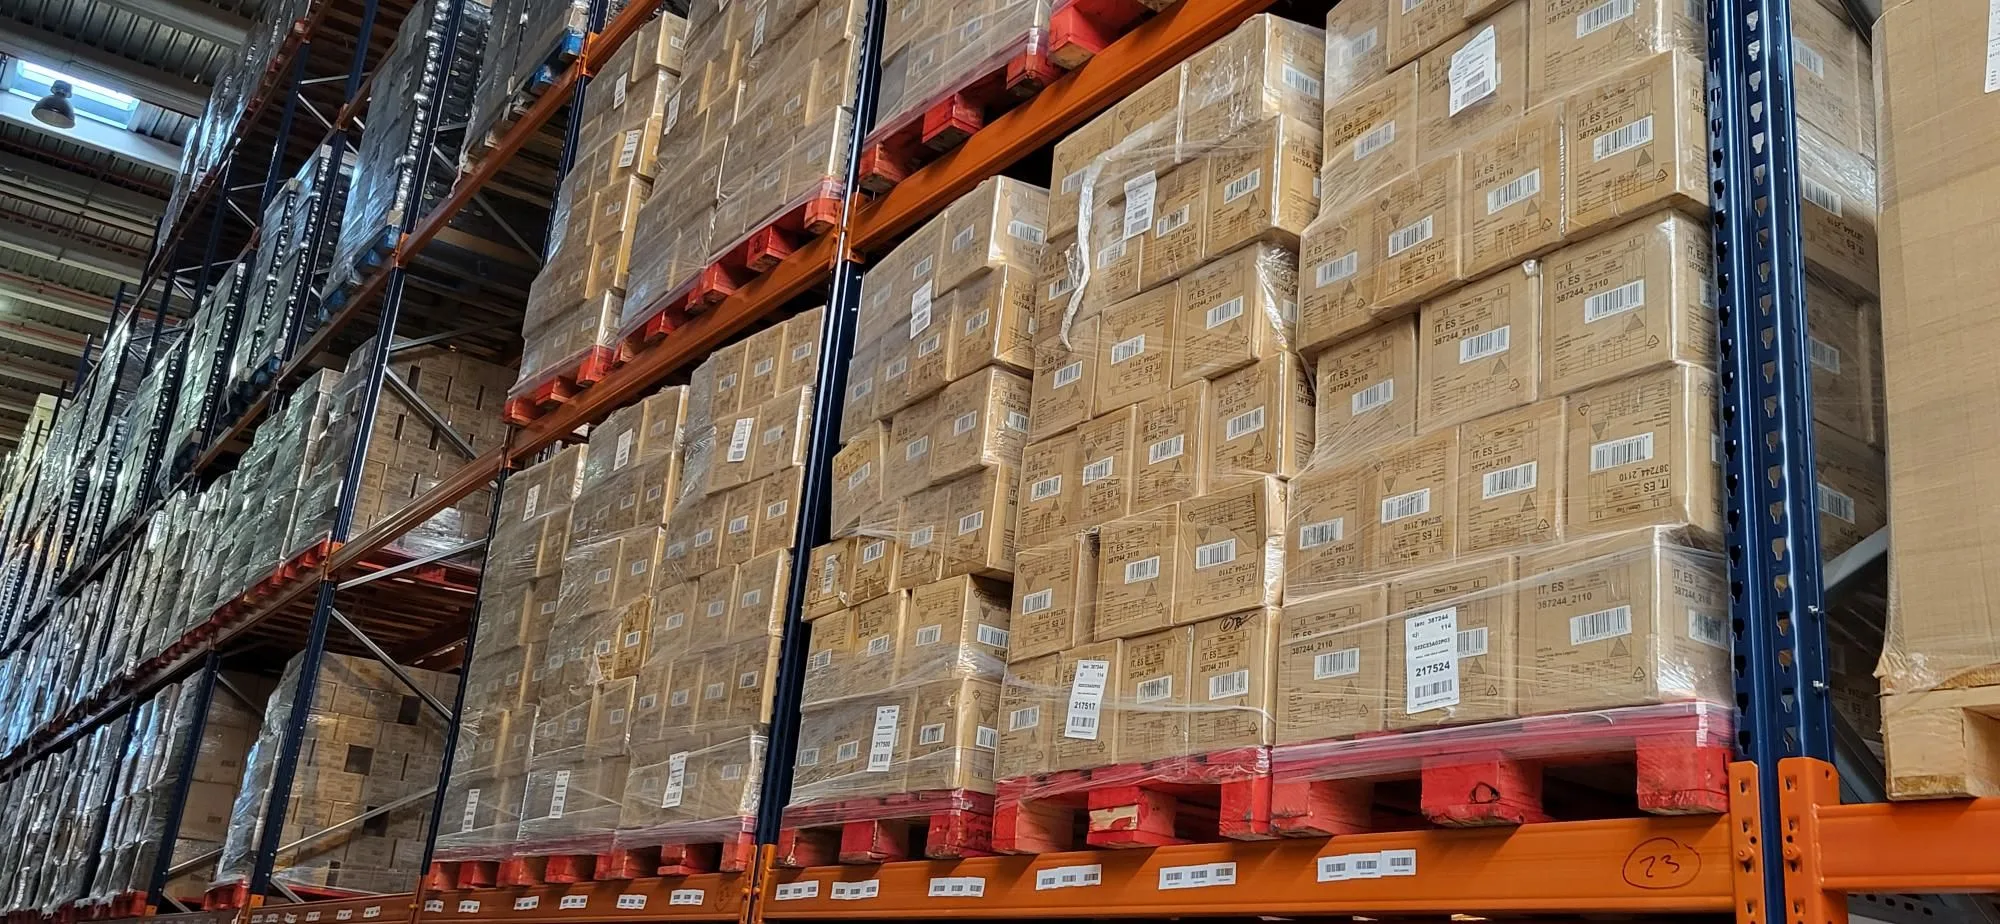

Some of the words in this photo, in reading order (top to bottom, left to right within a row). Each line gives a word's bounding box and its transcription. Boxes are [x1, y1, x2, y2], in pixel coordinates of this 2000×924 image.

[1590, 109, 1601, 122] ES
[1343, 122, 1353, 134] ES
[1484, 164, 1494, 175] ES
[1568, 274, 1580, 286] ES
[1556, 278, 1609, 303] 387244_2110
[1445, 319, 1456, 331] ES
[1434, 324, 1480, 346] 387244_2110
[1339, 370, 1349, 380] ES
[1482, 446, 1493, 456] ES
[1619, 463, 1669, 483] 387244_2110
[1643, 482, 1656, 494] ES
[1421, 530, 1433, 541] ES
[1116, 543, 1124, 552] ES
[1235, 576, 1245, 586] ES
[1683, 571, 1693, 584] ES
[1551, 581, 1565, 592] ES
[1537, 591, 1592, 610] 387244_2110
[1428, 613, 1449, 625] 387244
[1292, 639, 1333, 655] 387244_2110
[1209, 651, 1217, 659] ES
[1137, 658, 1144, 666] ES
[1415, 661, 1451, 677] 217524
[1074, 701, 1096, 711] 217517
[1640, 854, 1680, 878] 23
